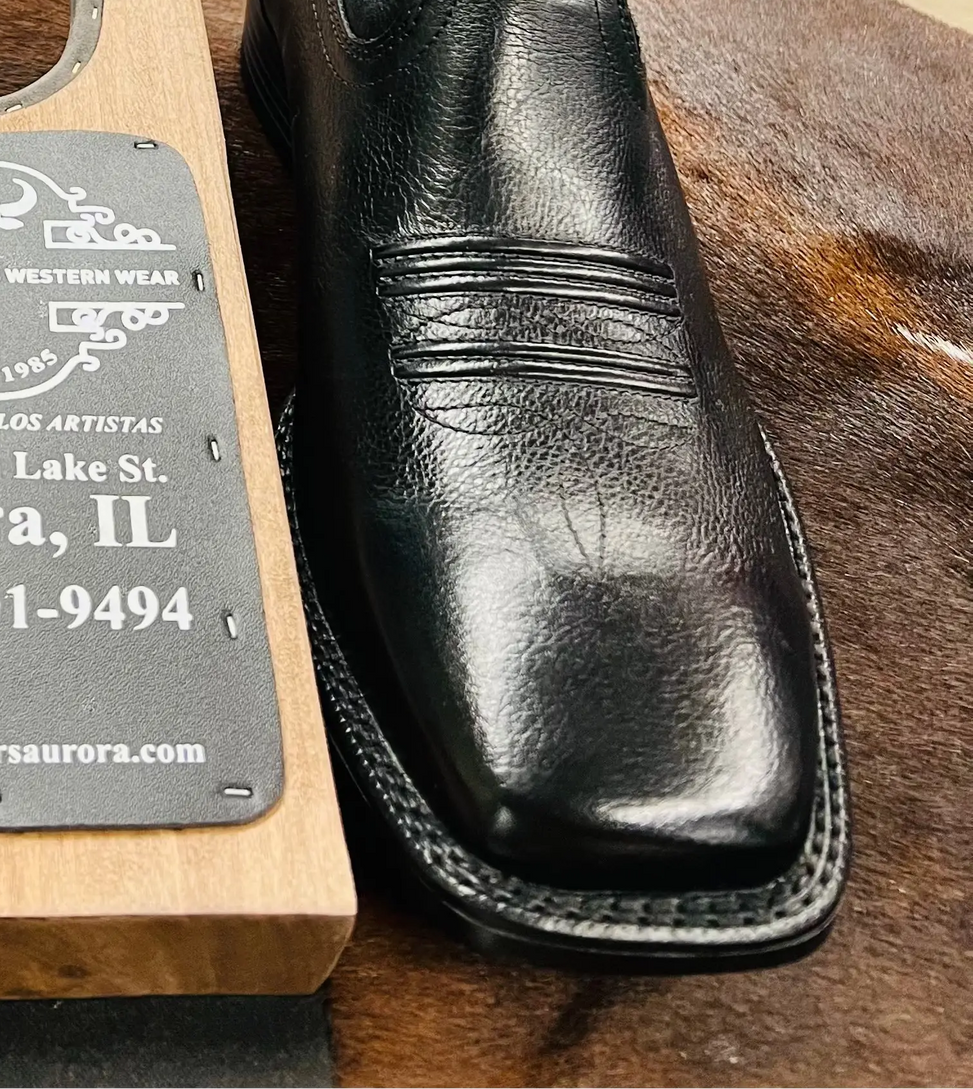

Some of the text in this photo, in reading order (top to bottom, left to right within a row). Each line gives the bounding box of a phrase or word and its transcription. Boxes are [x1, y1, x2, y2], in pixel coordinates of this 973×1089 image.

[4, 268, 111, 286] WESTERN
[114, 269, 181, 286] WEAR
[1, 348, 58, 383] 1985
[45, 414, 164, 434] ARTISTAS
[13, 451, 108, 483] Lake
[117, 453, 169, 484] St.
[89, 494, 177, 548] IL
